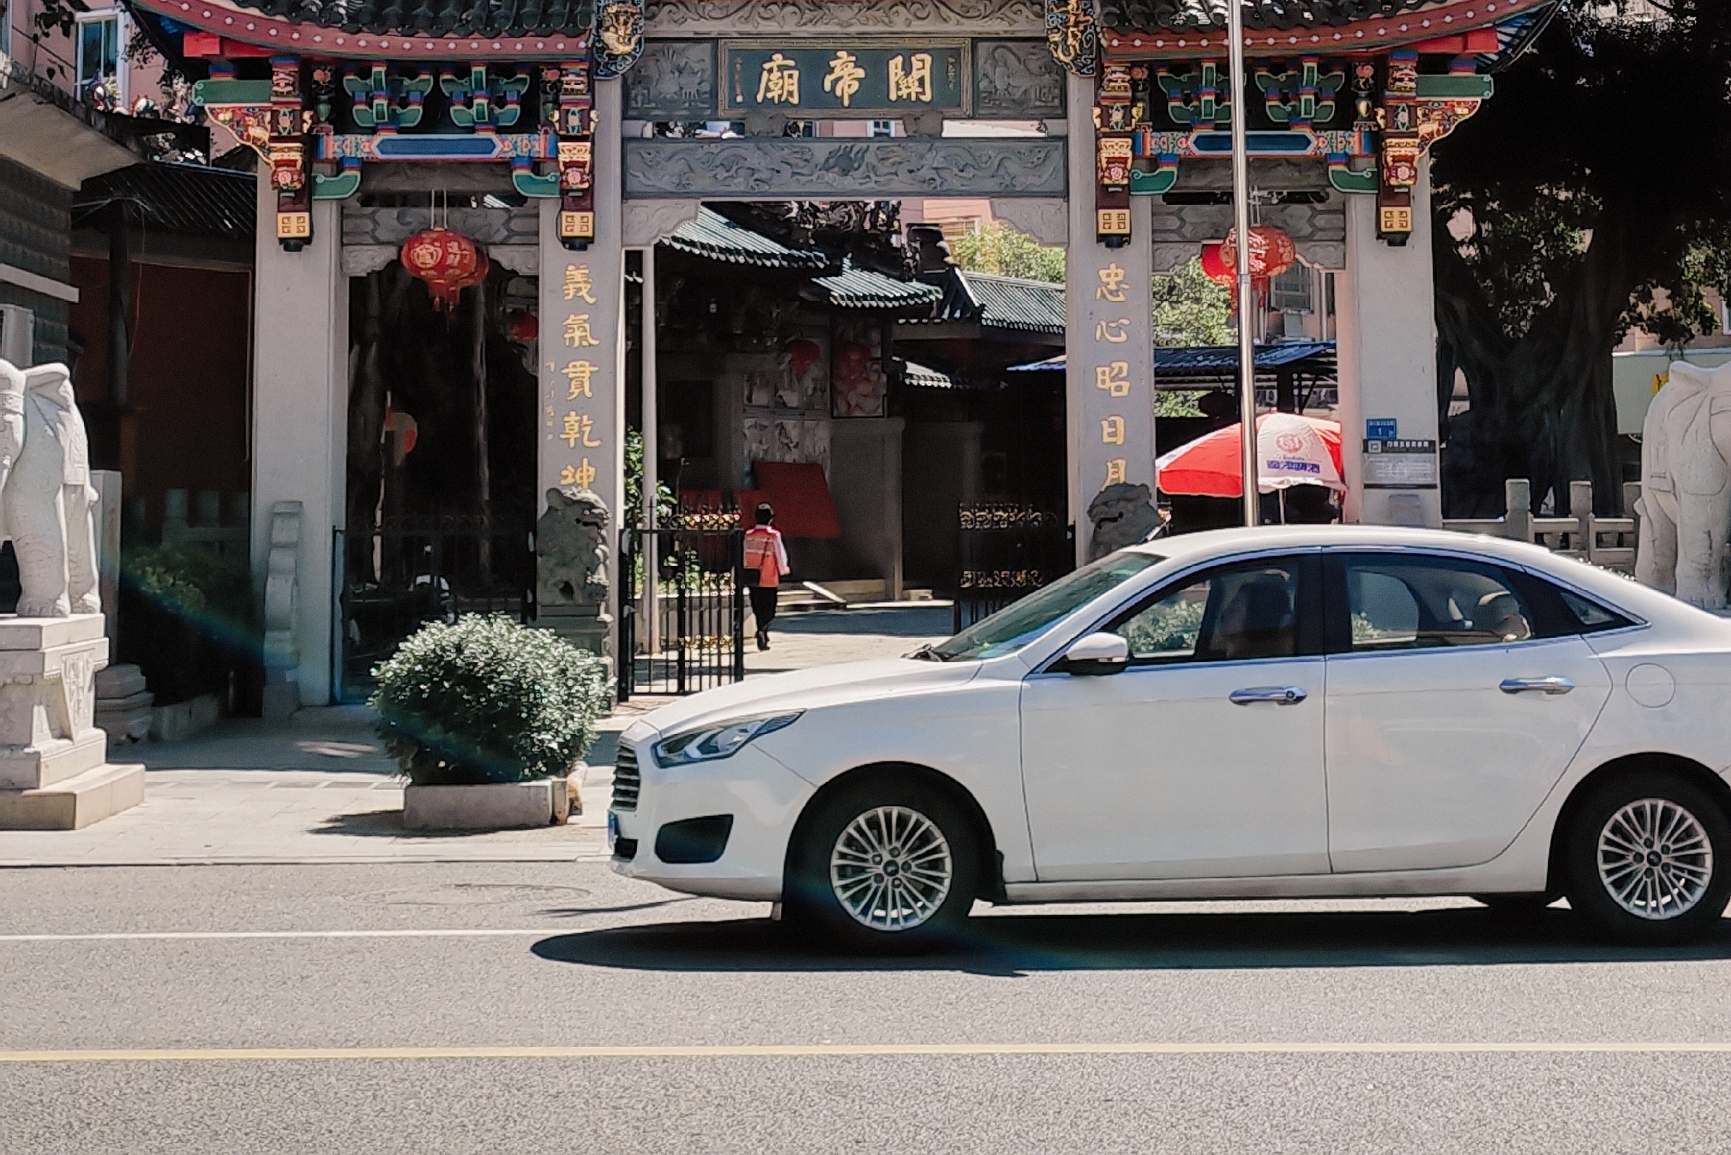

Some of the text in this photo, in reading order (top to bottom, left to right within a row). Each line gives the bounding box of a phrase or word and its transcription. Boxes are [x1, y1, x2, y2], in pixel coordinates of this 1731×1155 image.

[560, 264, 601, 489] 義氣貫乾坤
[1095, 262, 1131, 490] 忠心昭日月
